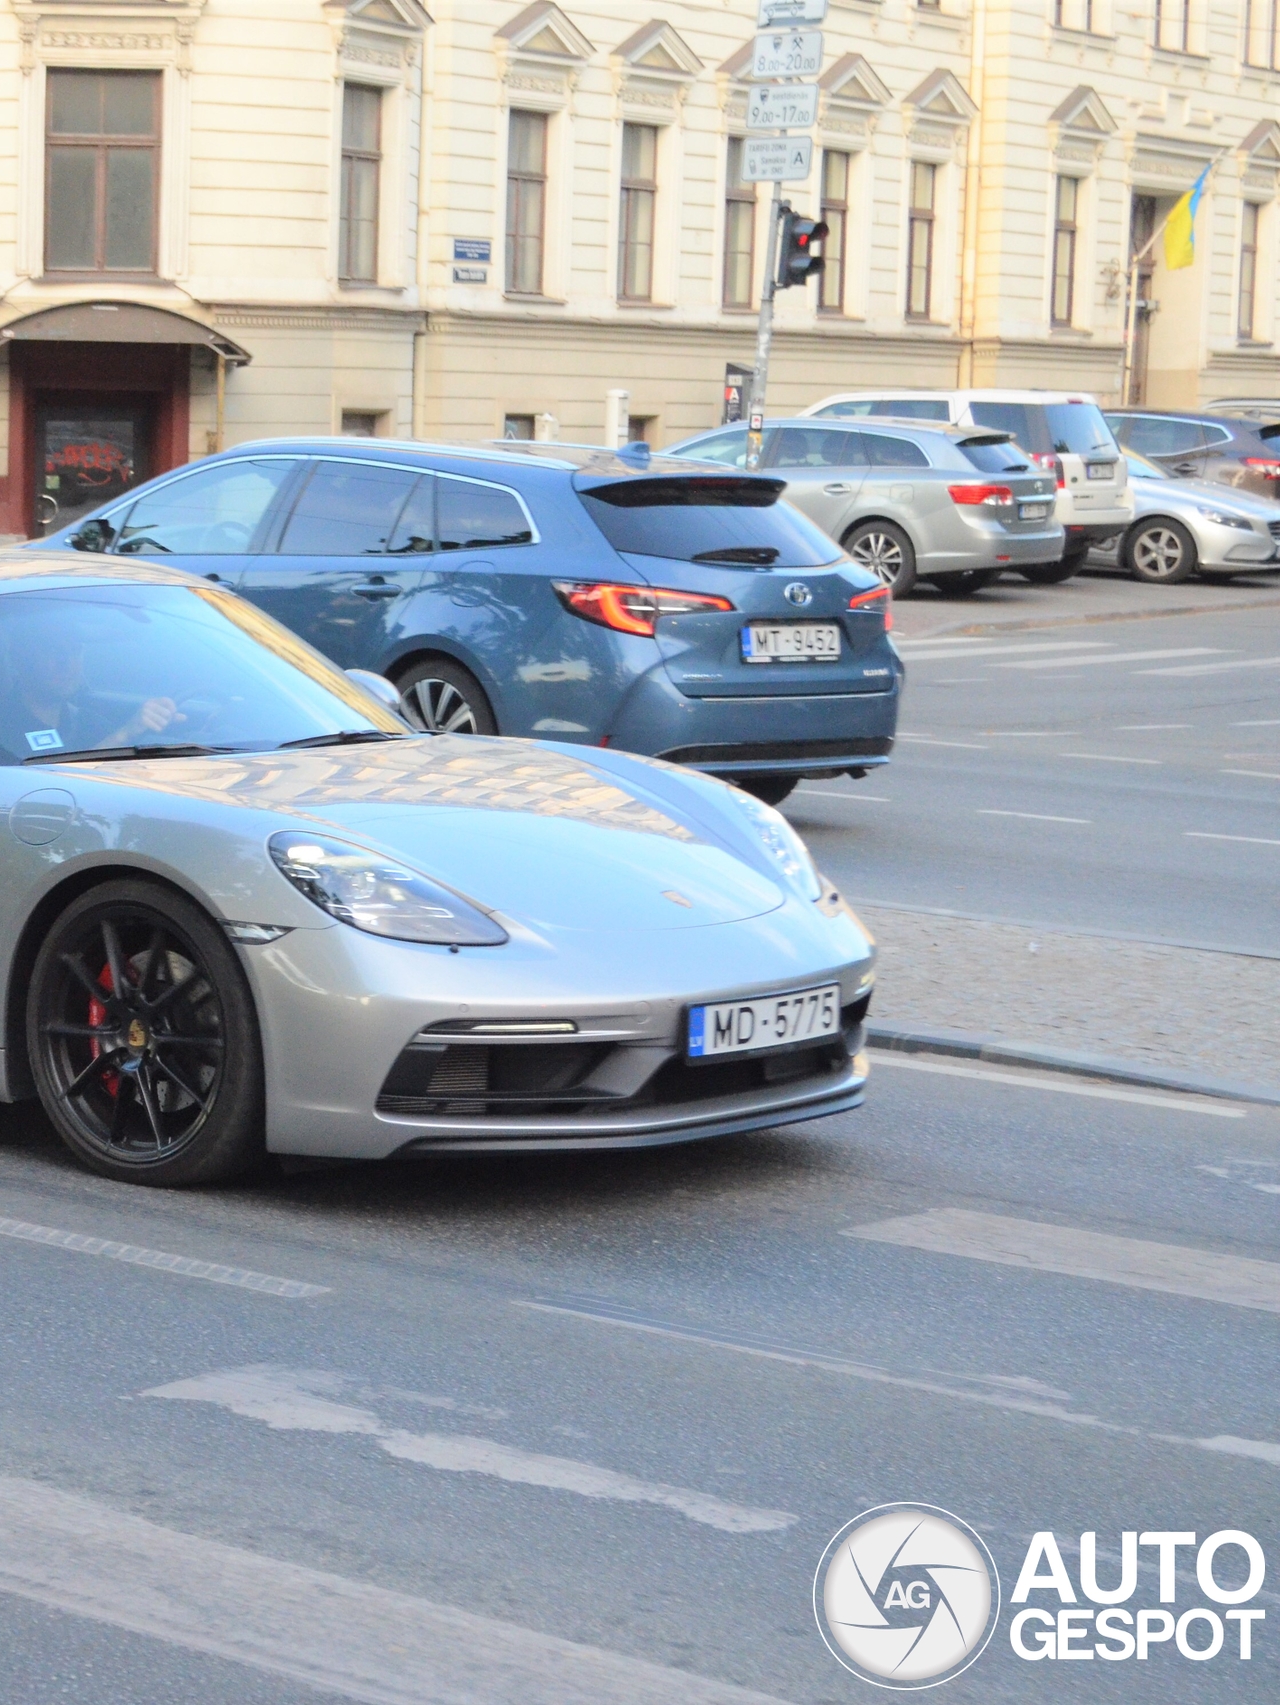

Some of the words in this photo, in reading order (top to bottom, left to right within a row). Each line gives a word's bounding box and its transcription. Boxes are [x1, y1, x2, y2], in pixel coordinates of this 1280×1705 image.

[757, 54, 815, 72] 8.00-20.00
[752, 106, 810, 124] 9.00-17.00
[793, 151, 804, 165] A
[755, 629, 836, 653] MT-9452
[713, 992, 834, 1049] MD-5775
